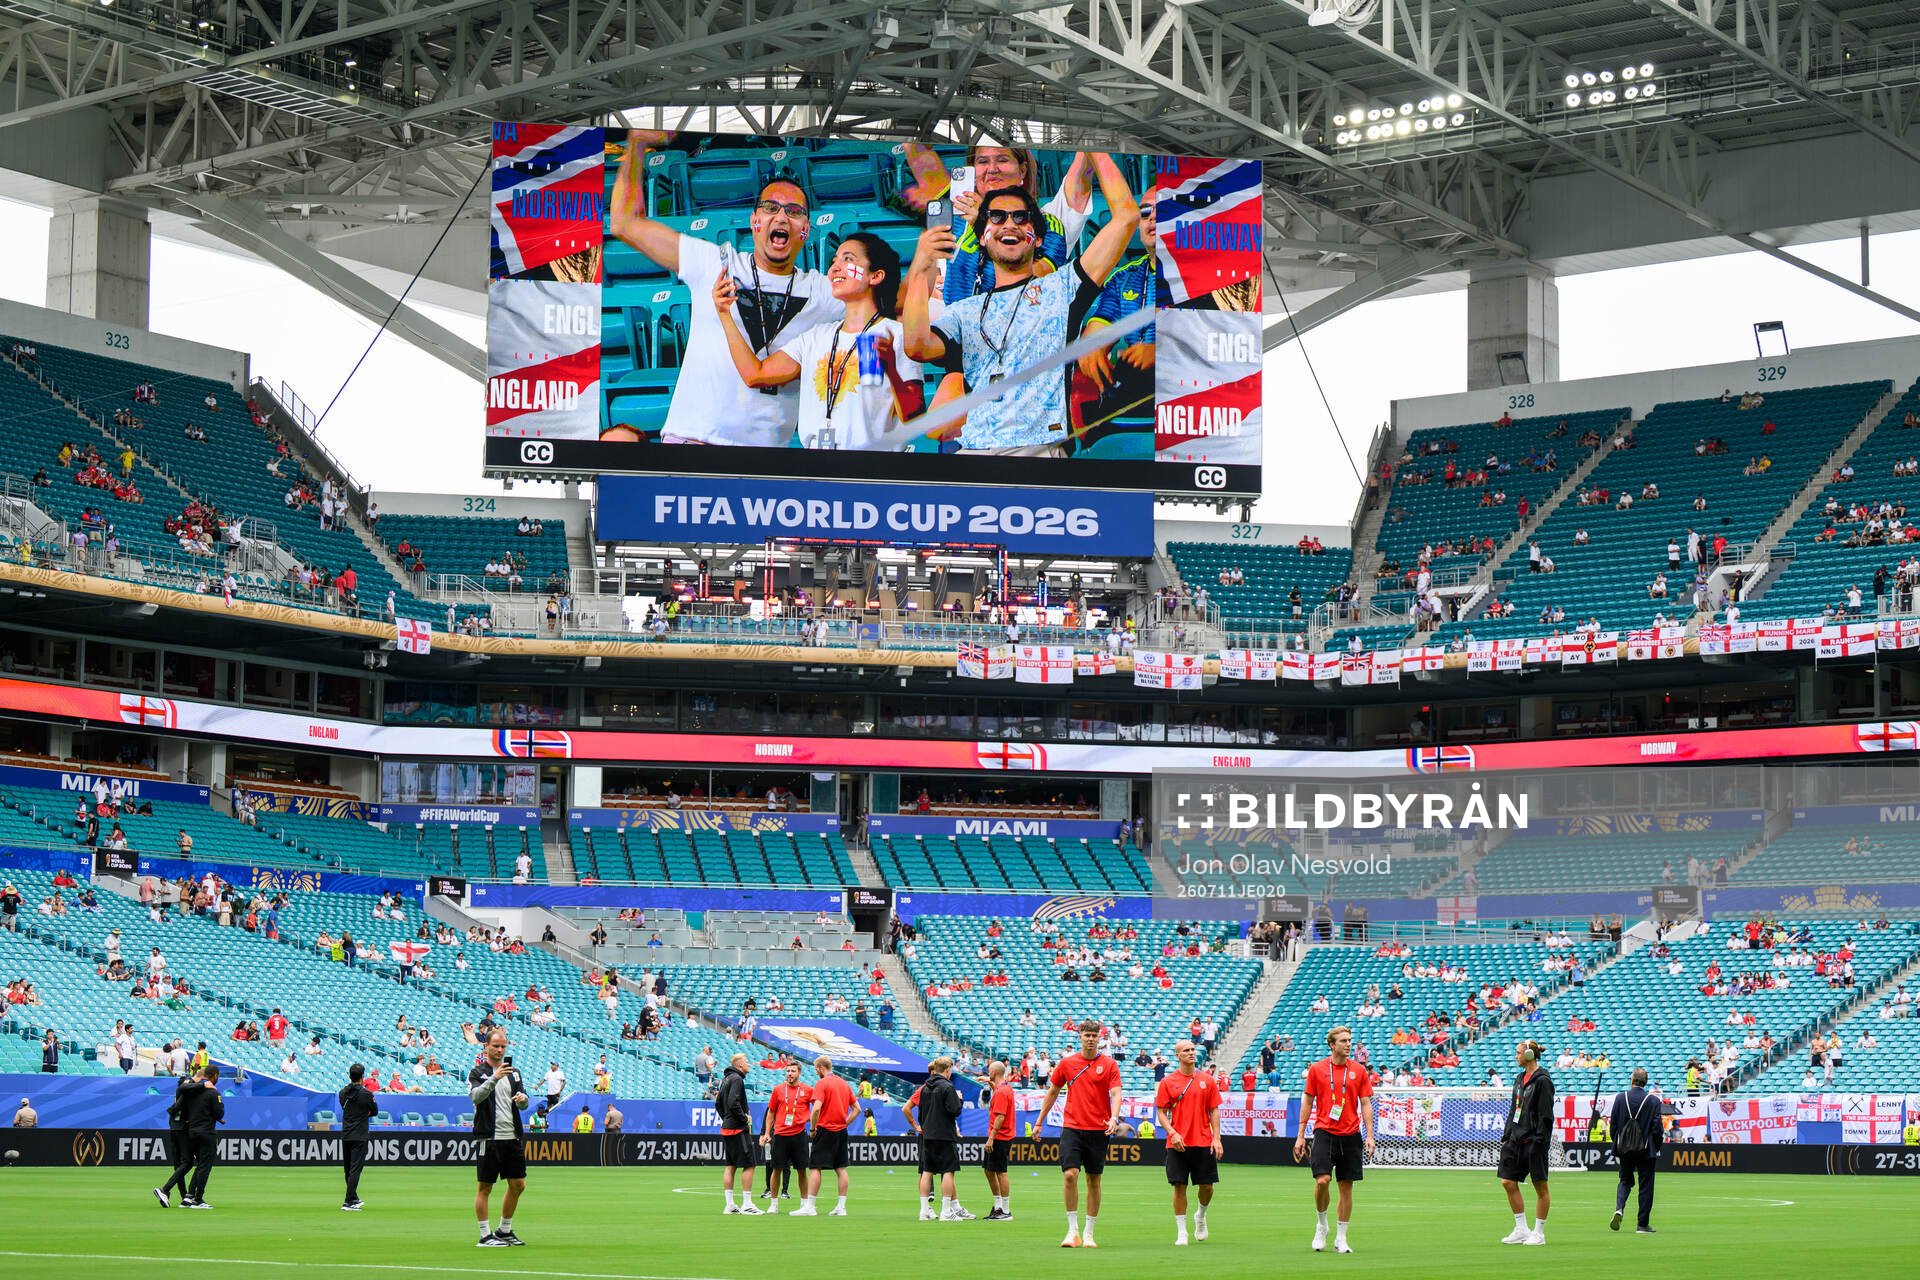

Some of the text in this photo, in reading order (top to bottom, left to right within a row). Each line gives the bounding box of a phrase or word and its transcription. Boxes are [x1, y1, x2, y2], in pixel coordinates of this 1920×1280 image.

[652, 156, 663, 165] 12
[512, 189, 604, 221] NORWAY
[694, 220, 706, 229] 13
[821, 215, 831, 223] 14
[1175, 221, 1262, 253] NORWAY
[656, 292, 667, 301] 14
[105, 333, 130, 350] 323
[1757, 366, 1786, 382] 329
[486, 378, 579, 411] NGLAND
[1508, 393, 1535, 409] 328
[1155, 404, 1242, 437] NGLAND
[524, 444, 551, 461] CC
[1198, 469, 1224, 486] CC
[463, 497, 497, 513] 324
[655, 495, 1099, 537] FIFA WORLD CUP 2026
[1231, 525, 1263, 540] 327
[1764, 629, 1794, 637] RUNNING
[1830, 637, 1860, 645] RAUNDS
[1471, 650, 1507, 659] ARSENAL
[1136, 665, 1188, 674] PORTSMOUTH
[309, 725, 339, 740] ENGLAND
[755, 743, 793, 757] NORWAY
[1640, 741, 1677, 756] NORWAY
[1212, 755, 1251, 768] ENGLAND
[420, 808, 500, 823] #FIFAWorldCup
[955, 819, 1047, 836] MIAMI
[692, 1107, 722, 1126] FIFA
[1464, 1113, 1505, 1130] FIFA
[1712, 1116, 1797, 1131] BLACKPOOL FC
[118, 1138, 167, 1160] FIFA
[404, 1140, 444, 1161] CUP
[524, 1141, 573, 1161] MIAMI
[637, 1141, 726, 1161] 27-31 JANU
[881, 1143, 919, 1162] YOUR
[1566, 1150, 1601, 1165] CUP
[1672, 1150, 1732, 1167] MIAMI
